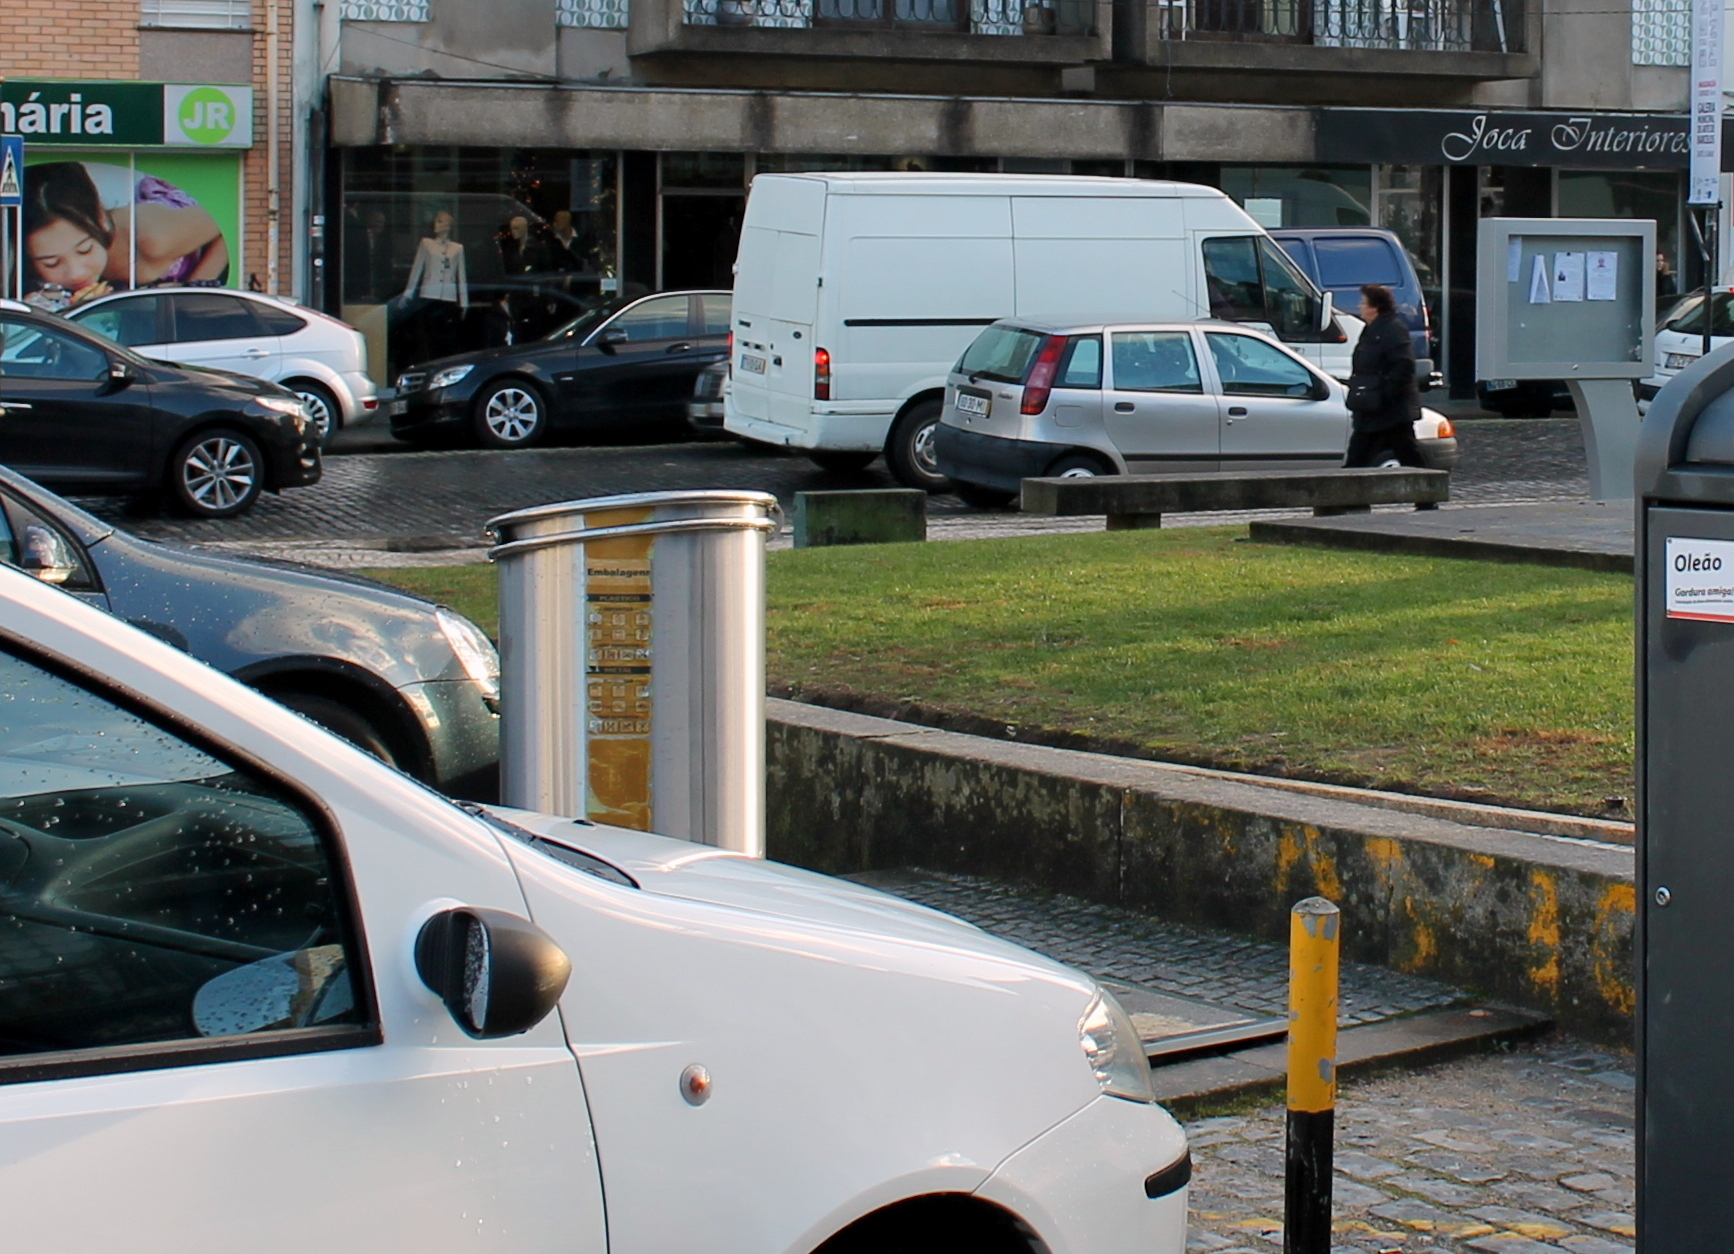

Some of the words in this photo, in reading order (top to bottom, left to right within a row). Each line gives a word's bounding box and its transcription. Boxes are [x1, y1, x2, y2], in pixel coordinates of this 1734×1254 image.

[183, 101, 231, 130] JR
[1441, 115, 1532, 161] Joca
[1551, 118, 1691, 153] Interiores
[1675, 553, 1722, 572] Oleão
[1675, 587, 1706, 597] Gordura
